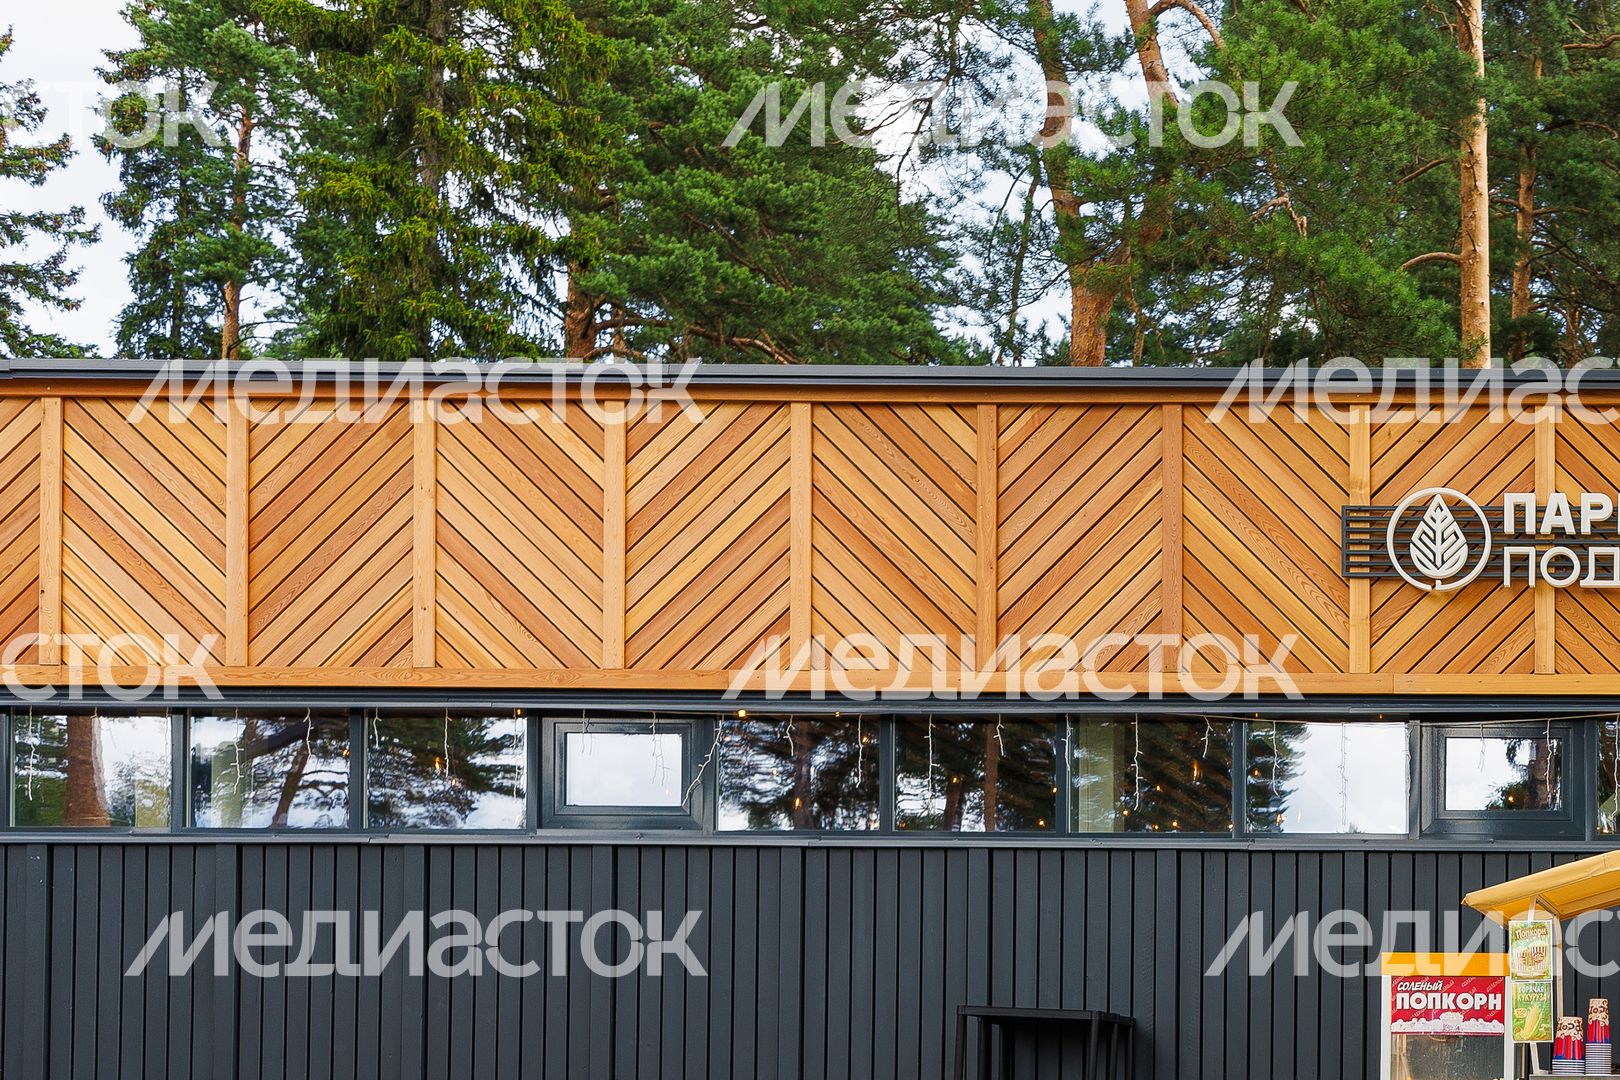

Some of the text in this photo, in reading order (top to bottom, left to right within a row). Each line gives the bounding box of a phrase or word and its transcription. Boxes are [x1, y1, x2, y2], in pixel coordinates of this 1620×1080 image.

[1515, 926, 1548, 940] Попкорн
[1397, 980, 1443, 991] СОЛЕНЫЙ
[1396, 992, 1502, 1010] ПОПКОРН
